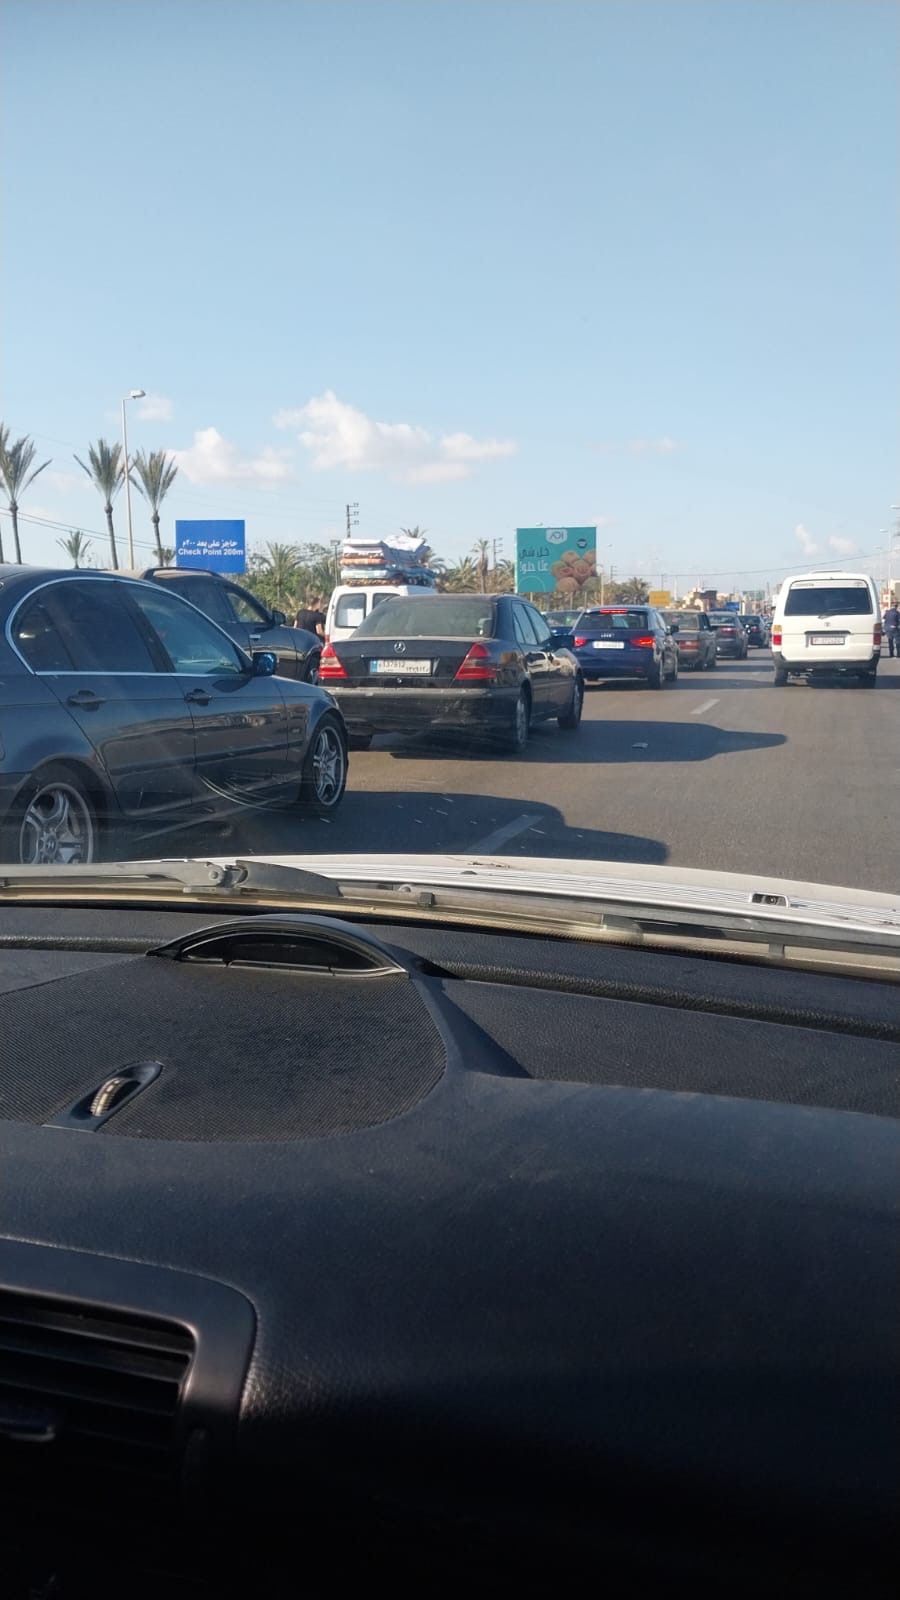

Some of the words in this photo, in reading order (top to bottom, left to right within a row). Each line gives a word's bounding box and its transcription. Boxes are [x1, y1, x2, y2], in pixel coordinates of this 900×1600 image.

[178, 548, 201, 556] Check
[202, 548, 222, 556] Point
[223, 548, 243, 556] 200m
